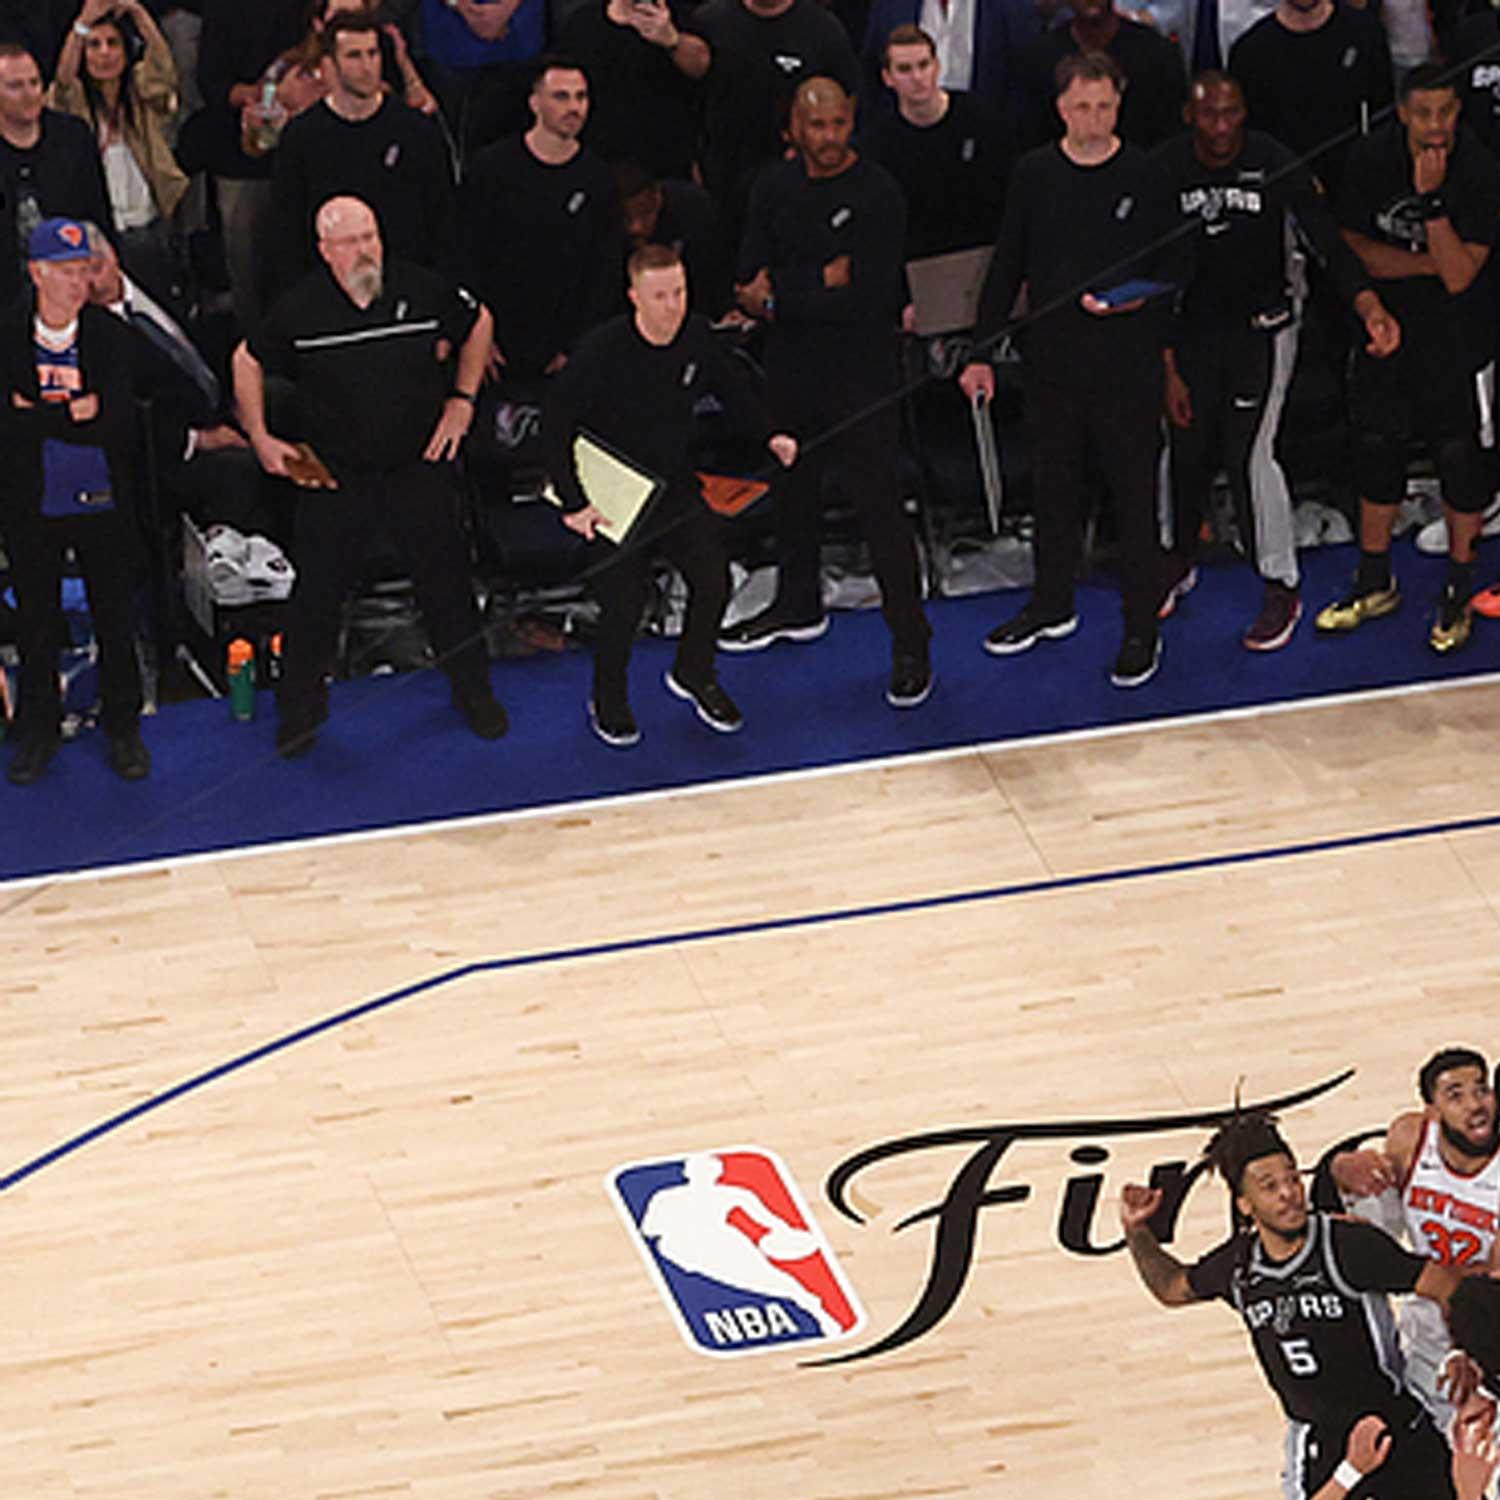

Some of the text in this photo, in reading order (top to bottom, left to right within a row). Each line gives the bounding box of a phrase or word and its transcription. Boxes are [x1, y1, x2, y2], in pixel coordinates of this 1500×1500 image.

[1421, 1219, 1481, 1267] 32
[703, 1301, 800, 1344] NBA
[1280, 1338, 1318, 1374] 5
